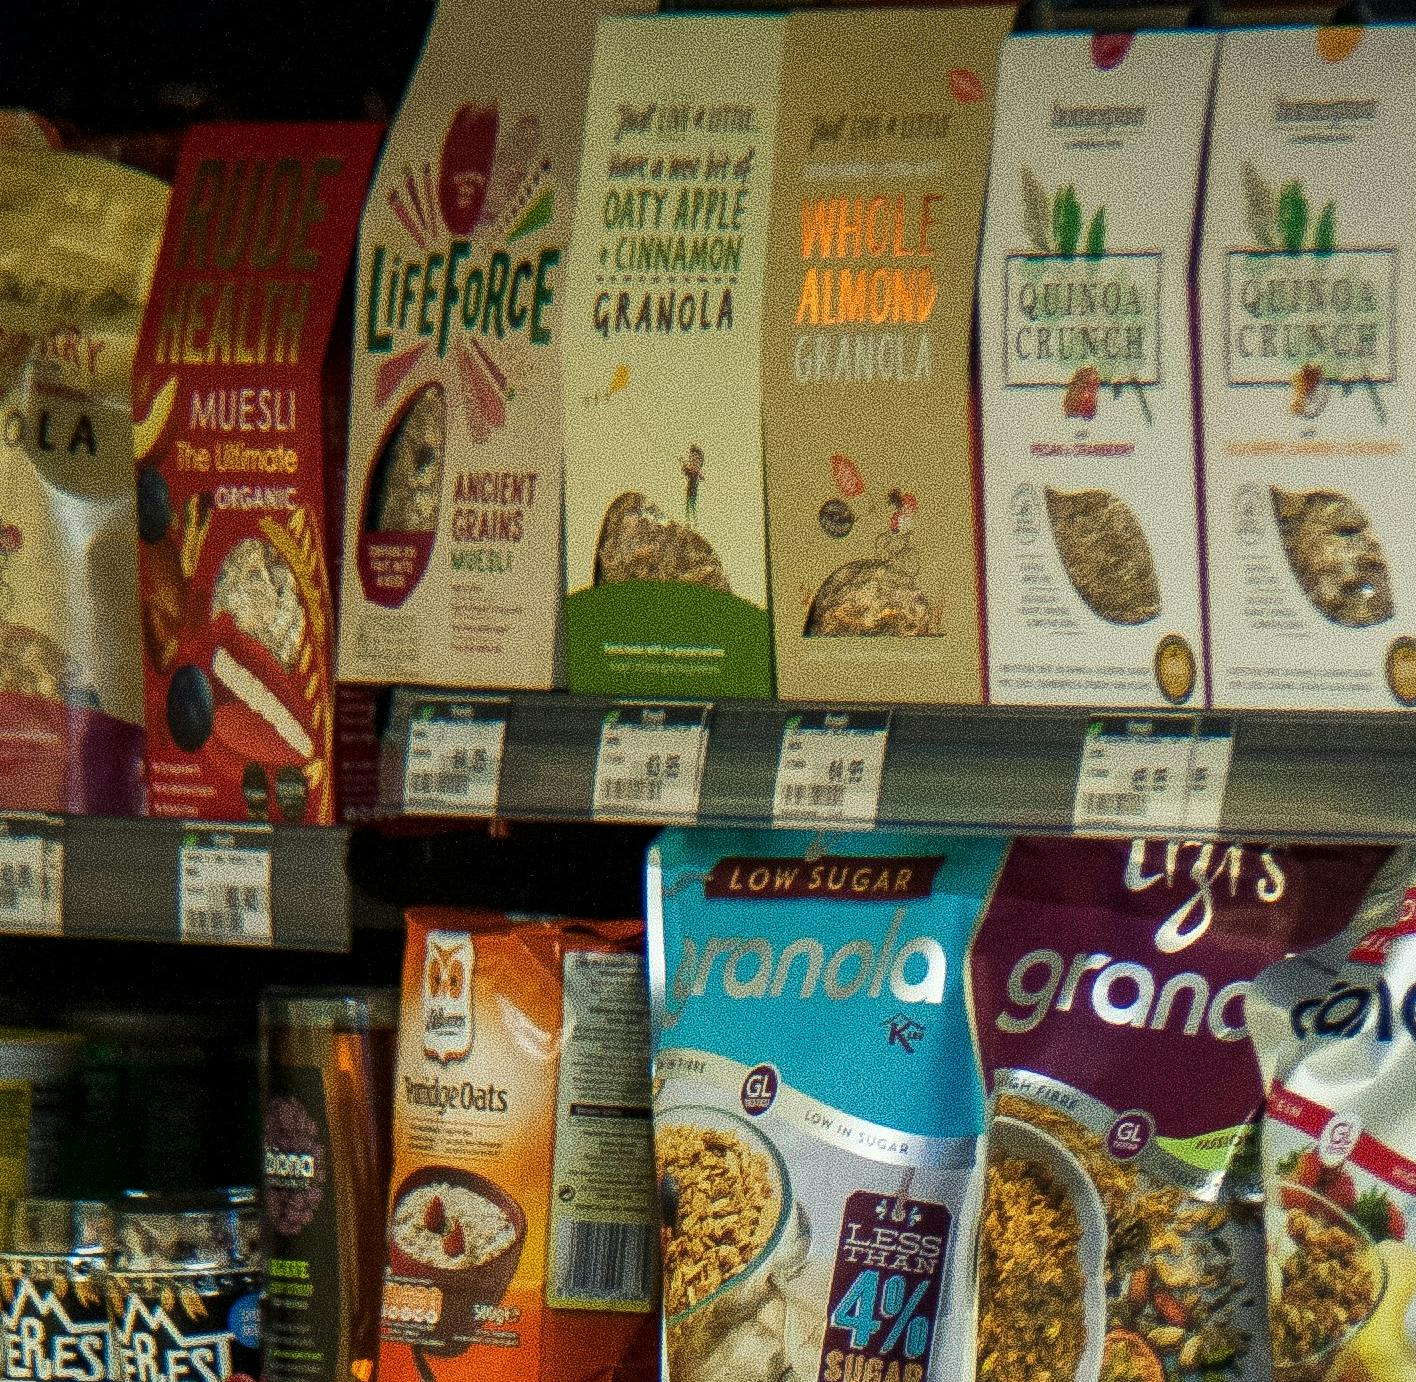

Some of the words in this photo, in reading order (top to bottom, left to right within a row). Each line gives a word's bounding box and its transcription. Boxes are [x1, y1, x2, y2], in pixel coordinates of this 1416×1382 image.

[176, 156, 343, 271] RUDE
[602, 187, 668, 230] OATY
[673, 185, 750, 231] APPLE
[800, 194, 946, 261] WHOLE
[614, 235, 745, 273] CINNAMON
[592, 286, 734, 338] GRANOLA
[794, 265, 940, 327] ALMOND
[1018, 280, 1144, 322] QUINOA
[1238, 277, 1377, 320] QUINOA
[155, 279, 312, 366] HEALTH
[1235, 322, 1378, 360] CRUNCH
[792, 331, 933, 385] GRANOLA
[1015, 325, 1146, 362] CRUNCH
[189, 386, 298, 433] MUESLI
[175, 440, 211, 472] The
[213, 443, 299, 475] Ultimate
[213, 486, 298, 512] ORGANIC
[451, 470, 538, 507] ANCIENT
[451, 508, 524, 544] GRAINS
[728, 864, 797, 892] LOW
[806, 862, 917, 894] SUGAR
[460, 1080, 509, 1114] Oats
[746, 1075, 773, 1101] GL
[1115, 1121, 1143, 1145] GL
[846, 1221, 944, 1259] LESS
[844, 1244, 939, 1278] THAN
[831, 1268, 932, 1360] 4%
